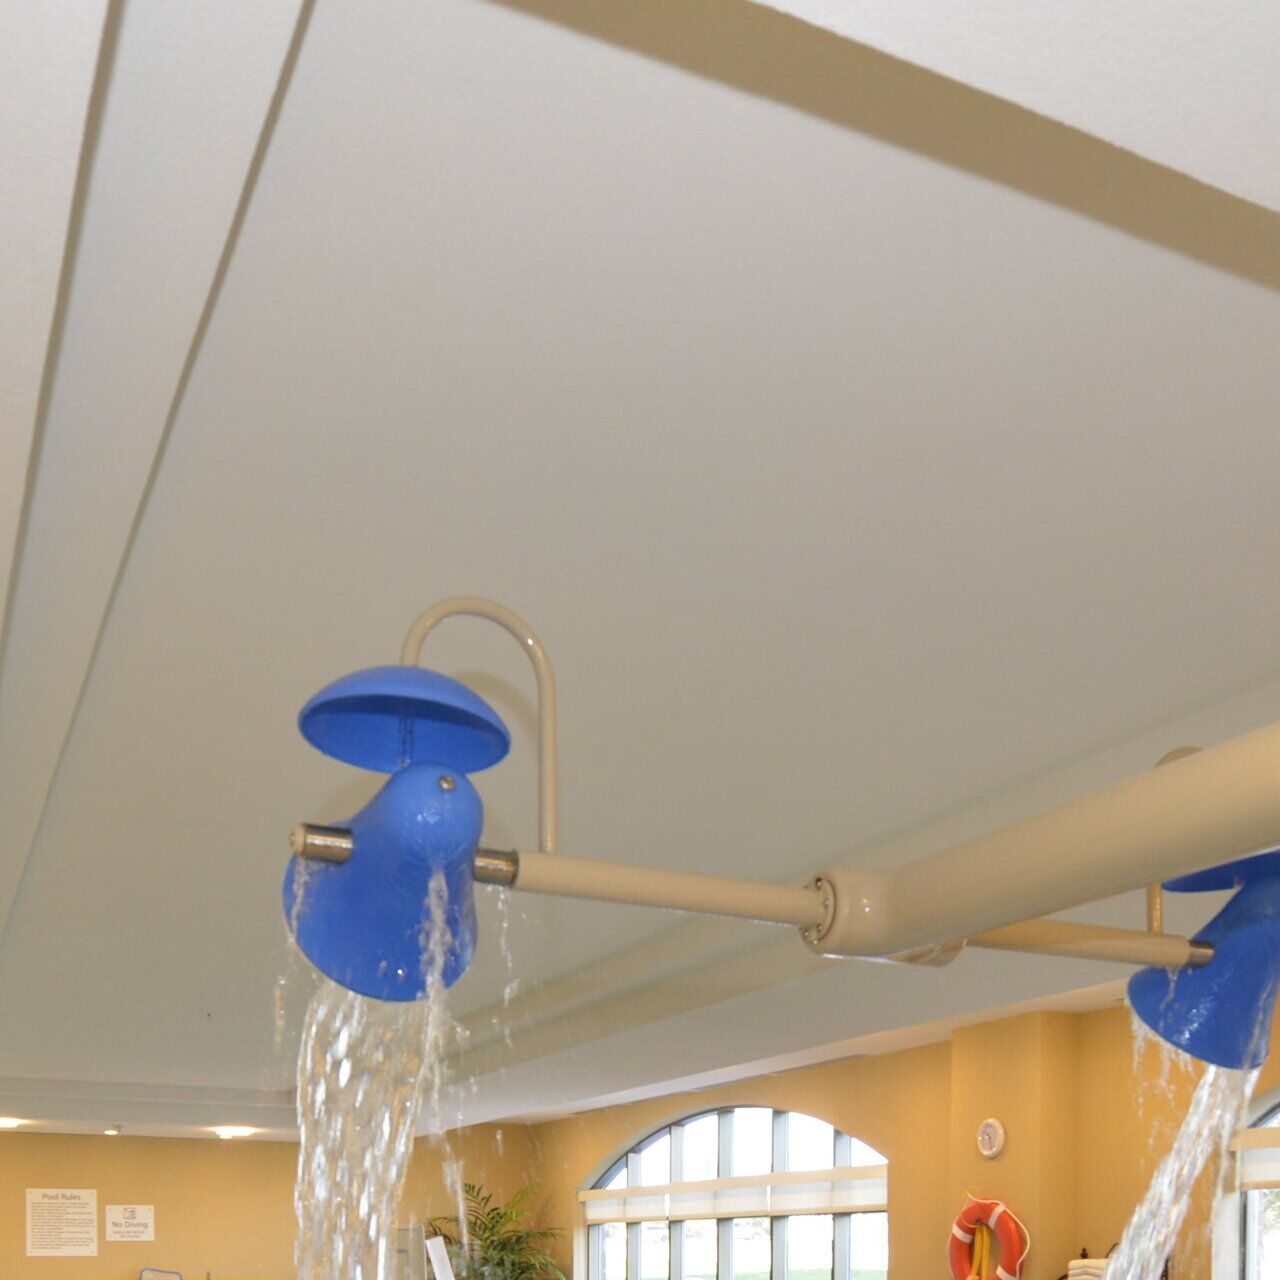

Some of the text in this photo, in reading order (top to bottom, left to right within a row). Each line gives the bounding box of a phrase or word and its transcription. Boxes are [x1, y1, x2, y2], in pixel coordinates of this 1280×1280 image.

[60, 1193, 81, 1201] Rules
[111, 1220, 148, 1229] No Diving
